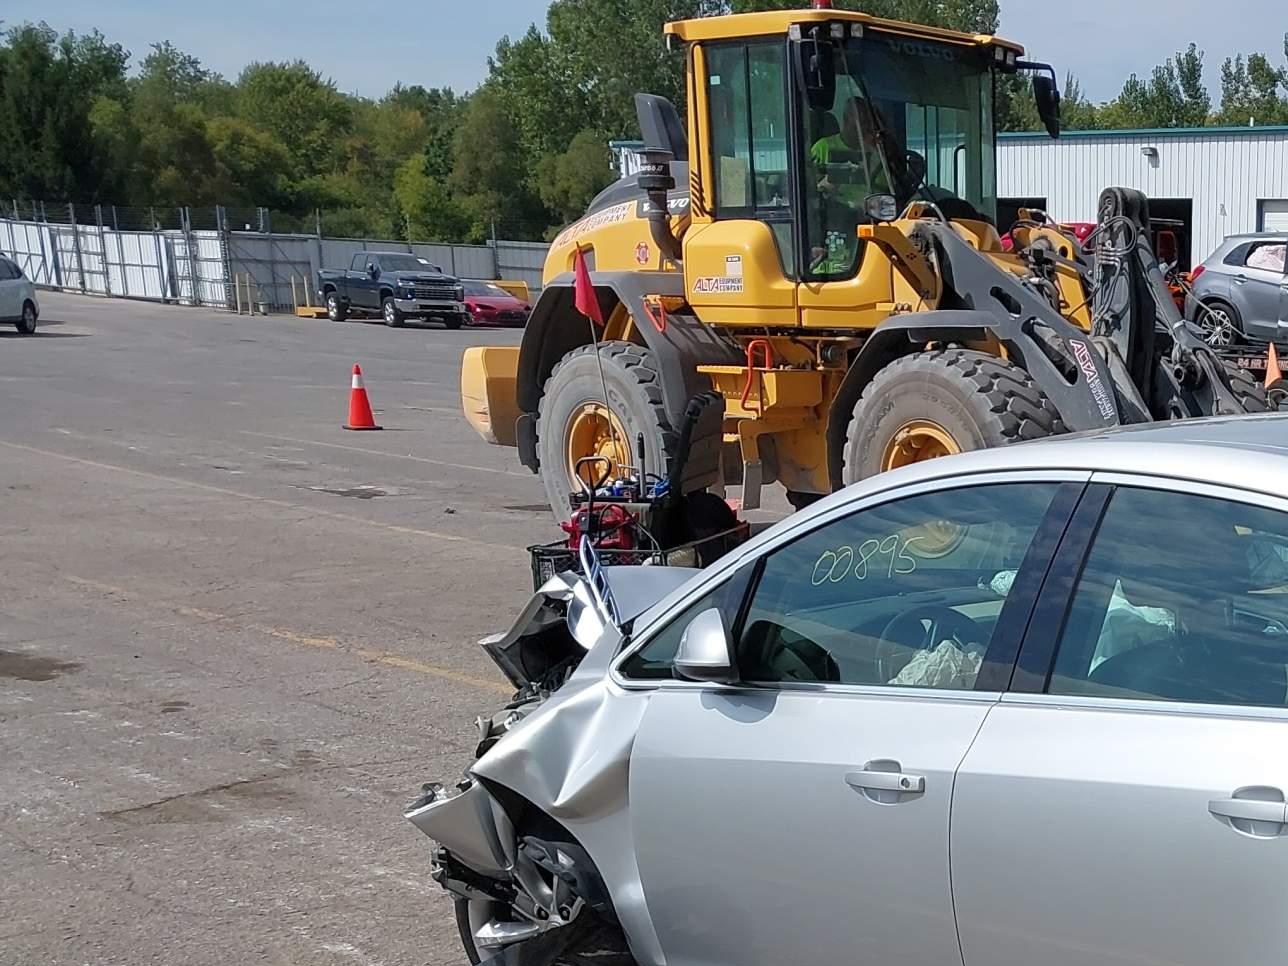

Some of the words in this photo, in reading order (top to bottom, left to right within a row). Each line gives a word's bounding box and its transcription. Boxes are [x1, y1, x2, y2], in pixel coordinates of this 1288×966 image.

[693, 278, 719, 291] ALTA
[1069, 340, 1098, 383] ALTA
[811, 534, 925, 586] 00895
